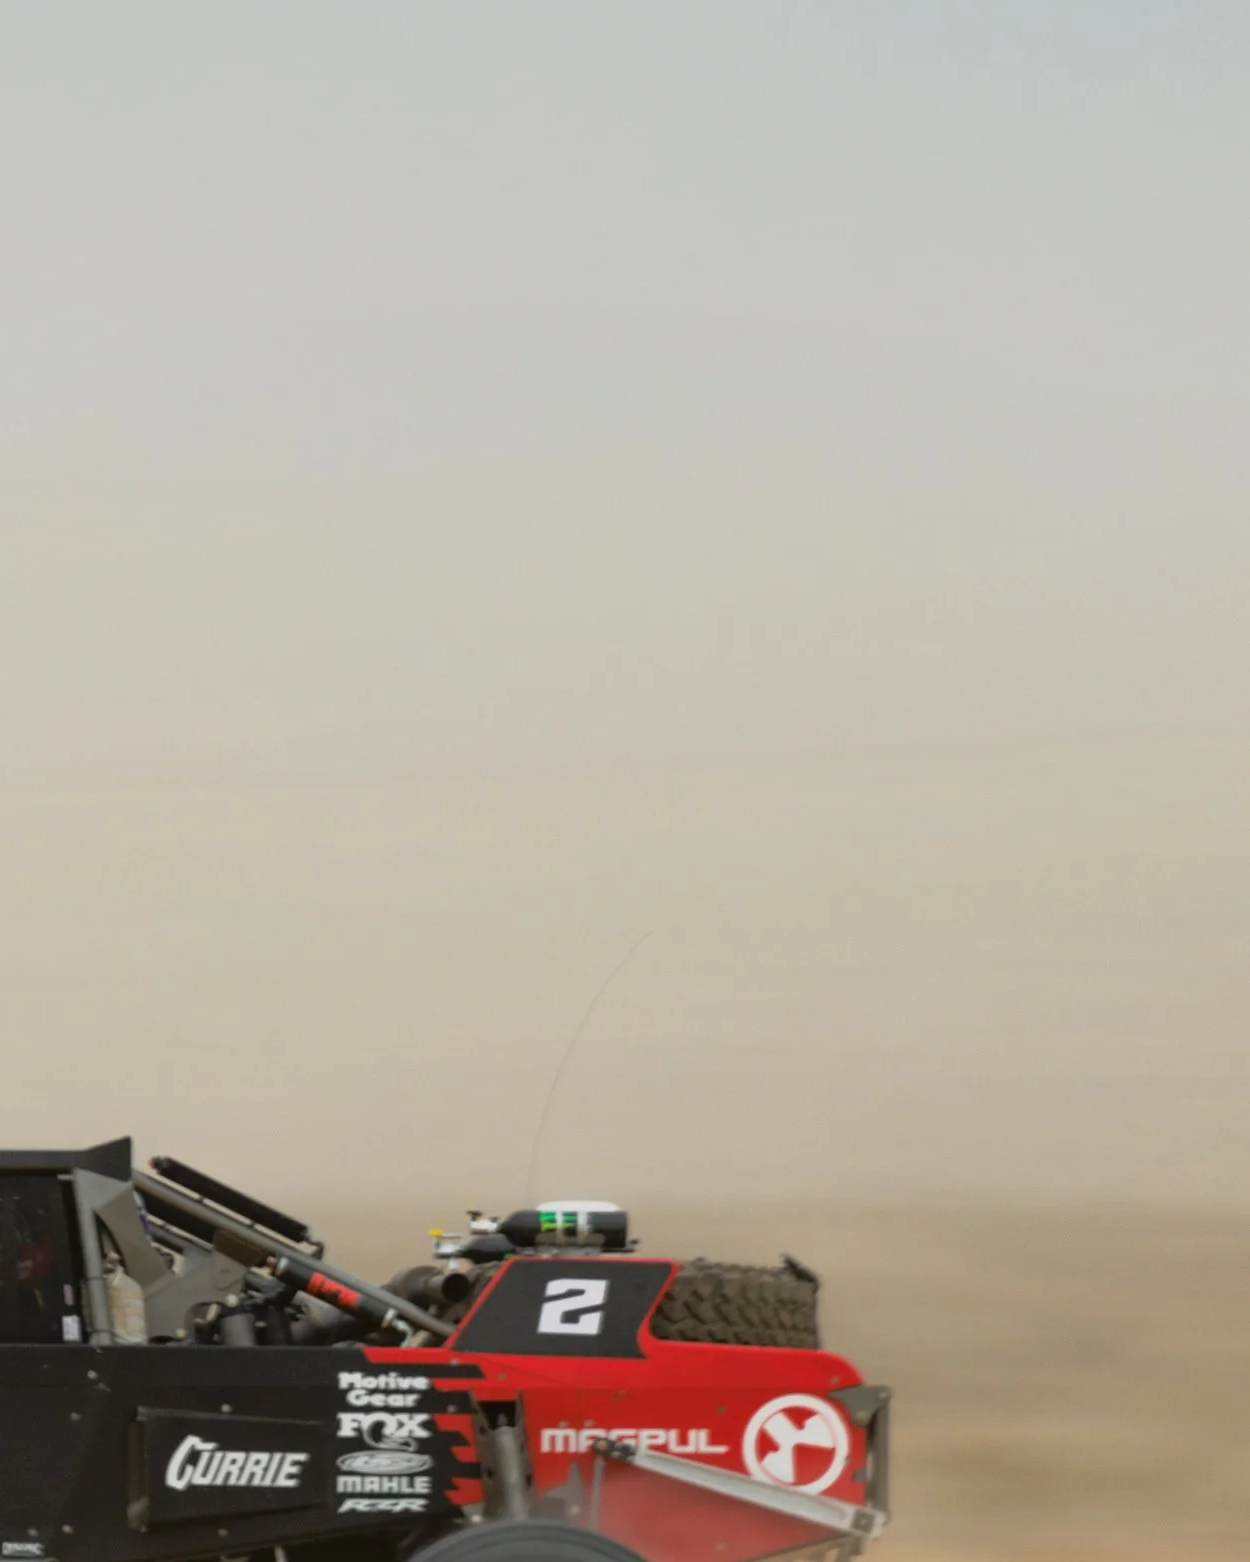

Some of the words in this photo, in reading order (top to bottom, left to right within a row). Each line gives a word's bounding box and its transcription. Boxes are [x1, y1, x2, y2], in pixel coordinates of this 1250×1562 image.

[537, 1278, 610, 1335] 2
[337, 1371, 430, 1390] Motive
[345, 1388, 421, 1408] Gear
[336, 1411, 432, 1441] FOX
[165, 1434, 311, 1491] CURRIE
[336, 1475, 432, 1494] MAHLE
